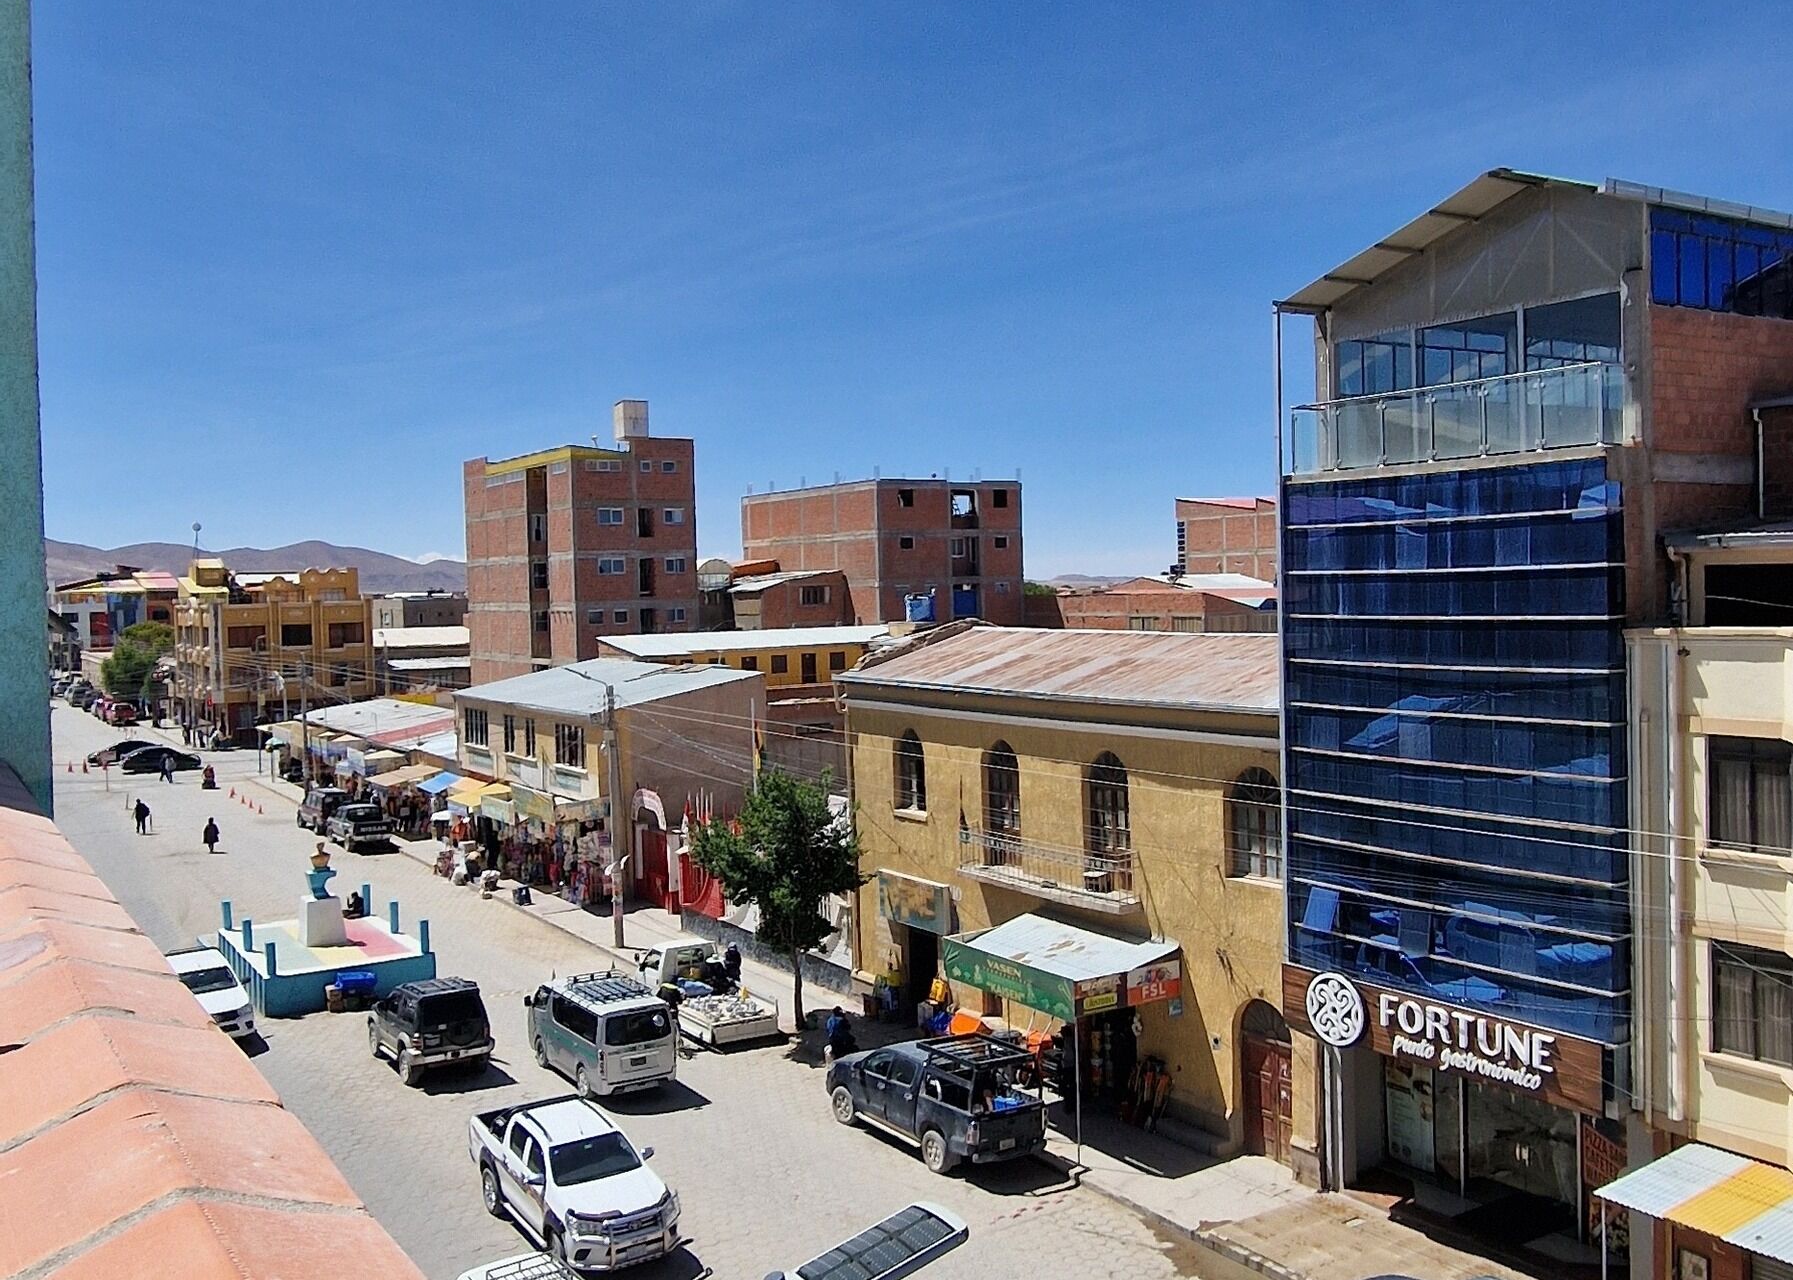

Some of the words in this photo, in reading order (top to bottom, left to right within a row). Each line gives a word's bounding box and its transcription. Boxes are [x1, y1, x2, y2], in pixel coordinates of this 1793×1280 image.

[1142, 982, 1167, 999] FSL
[1380, 994, 1555, 1073] FORTUNE
[1393, 1035, 1434, 1059] punto
[1439, 1047, 1542, 1090] gastronómico
